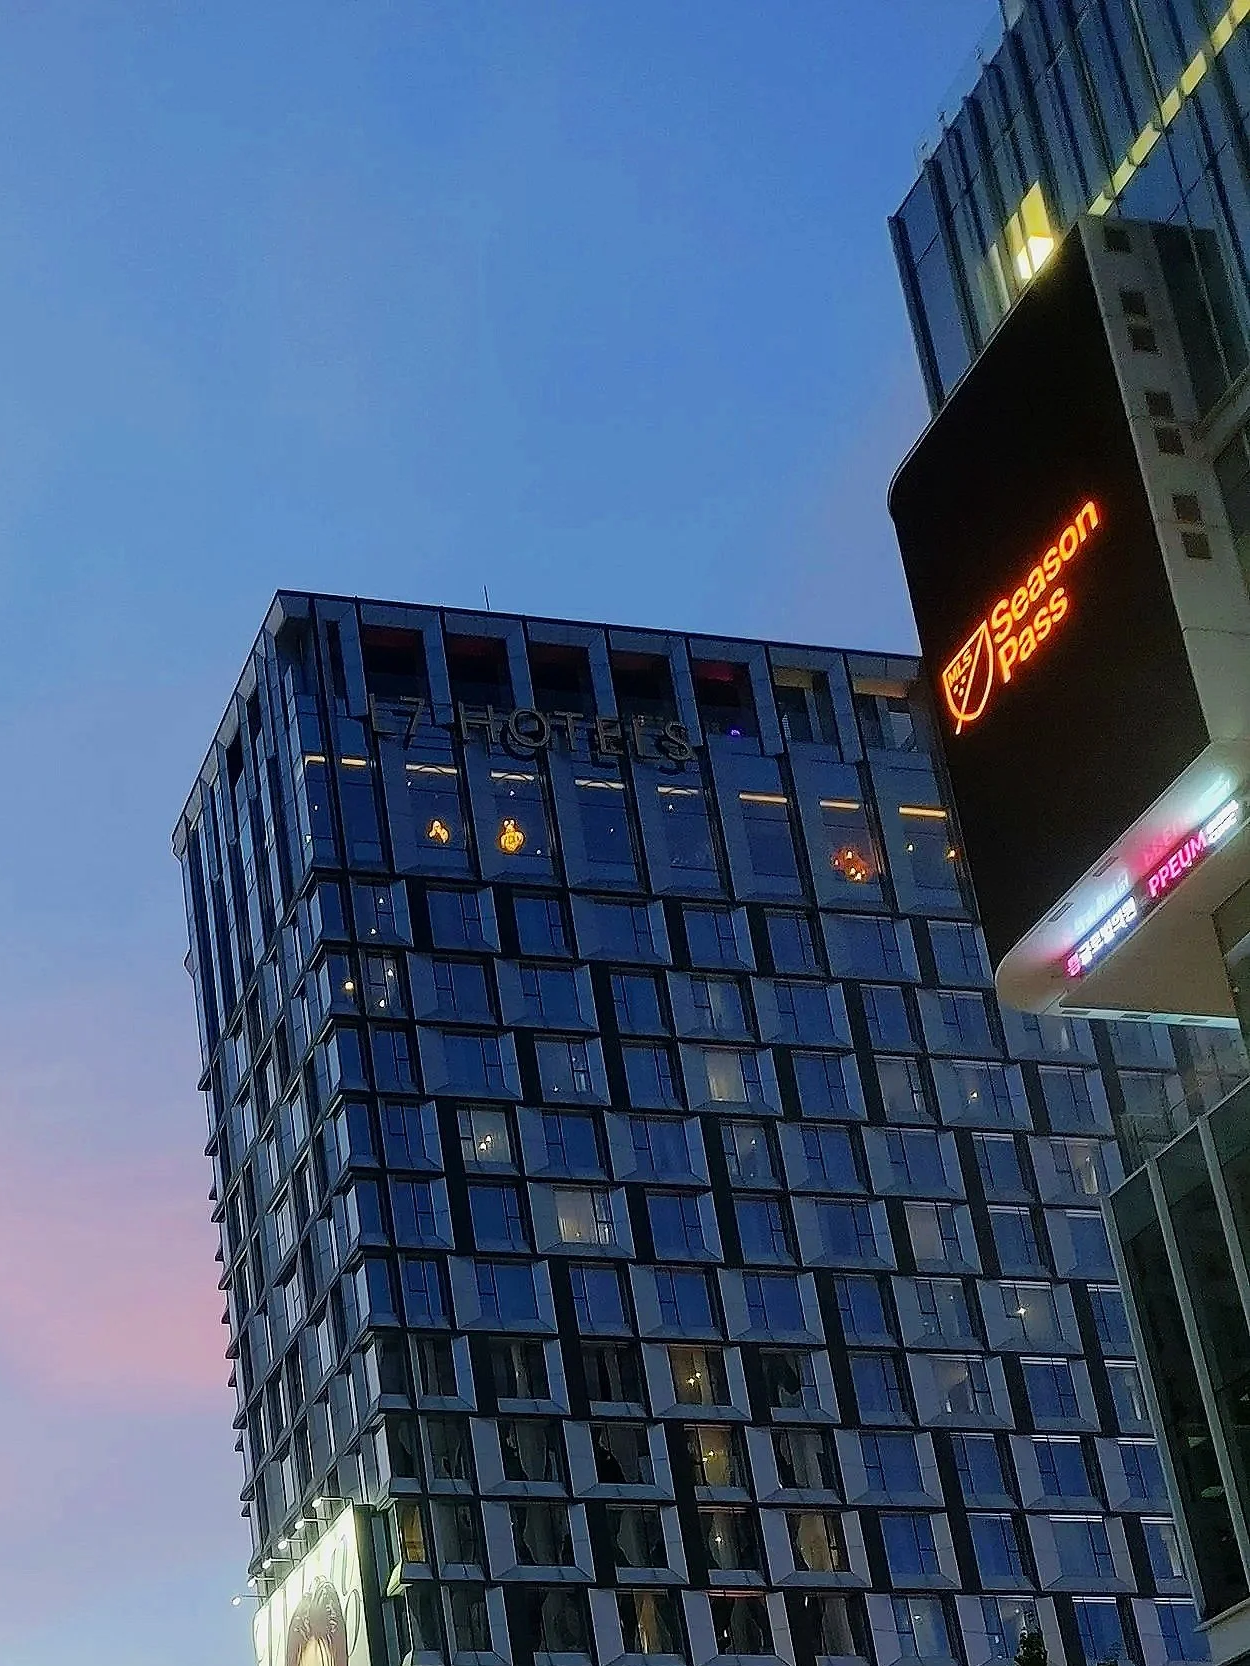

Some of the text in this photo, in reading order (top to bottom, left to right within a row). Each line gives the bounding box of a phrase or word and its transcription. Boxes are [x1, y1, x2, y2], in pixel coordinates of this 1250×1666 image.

[990, 500, 1100, 644] Season
[998, 584, 1069, 684] Pass
[947, 652, 973, 689] MLS
[456, 700, 698, 762] HOTELS
[1148, 828, 1208, 898] PPEUM
